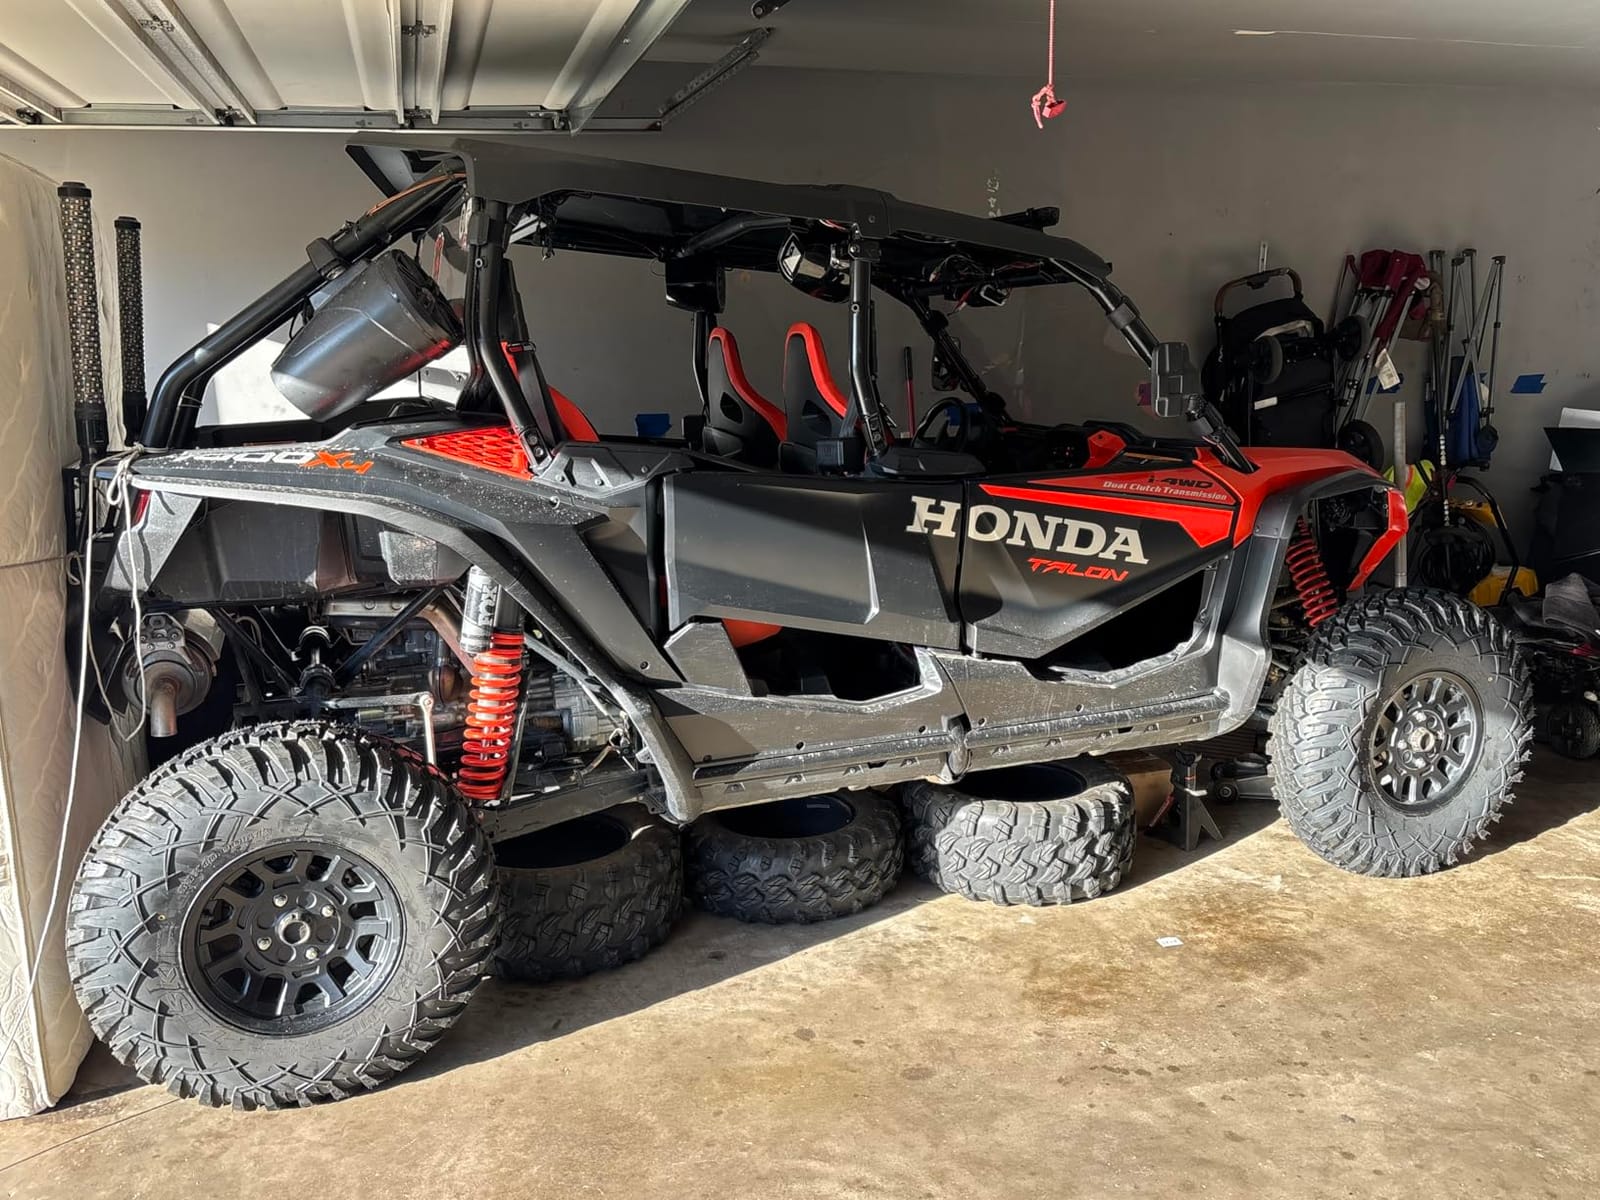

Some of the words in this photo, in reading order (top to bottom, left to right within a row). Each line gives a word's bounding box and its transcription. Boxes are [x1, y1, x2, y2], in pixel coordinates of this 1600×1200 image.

[1103, 481, 1127, 490] Dual
[1128, 483, 1162, 494] Clutch
[1162, 486, 1228, 501] Transmission
[905, 495, 1150, 565] HONDA
[1027, 557, 1129, 582] TALON
[478, 584, 498, 627] FOX
